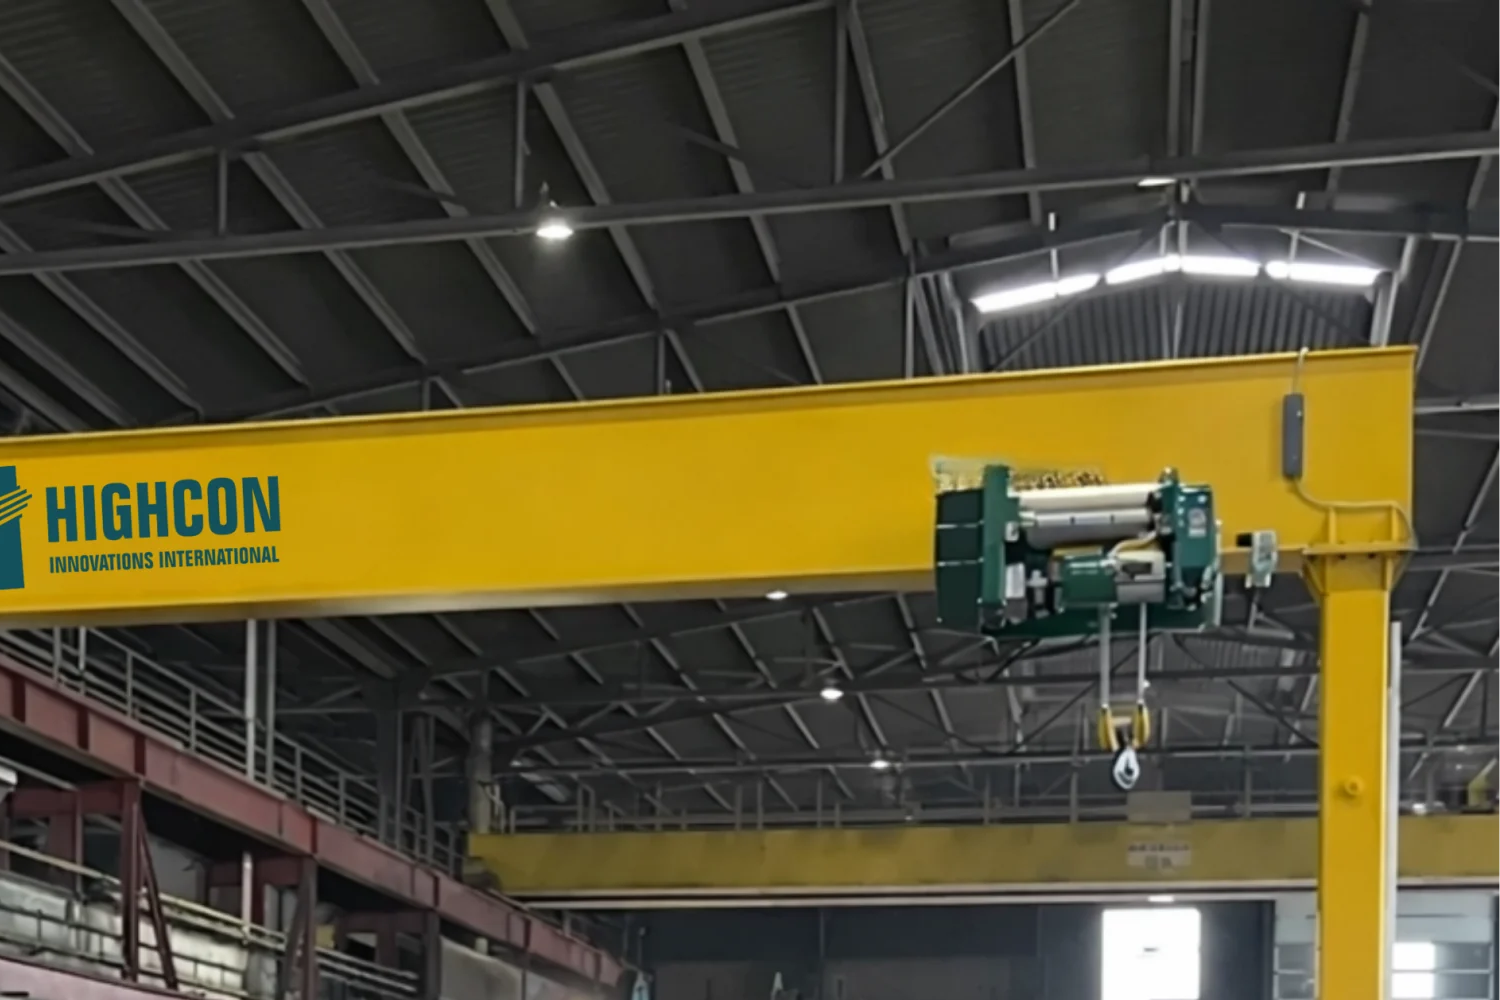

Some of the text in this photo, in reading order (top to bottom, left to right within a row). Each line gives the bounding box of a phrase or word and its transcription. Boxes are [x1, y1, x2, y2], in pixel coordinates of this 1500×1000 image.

[45, 475, 281, 543] HIGHCON
[49, 545, 280, 574] INNOVATIONS INTERNATIONAL
